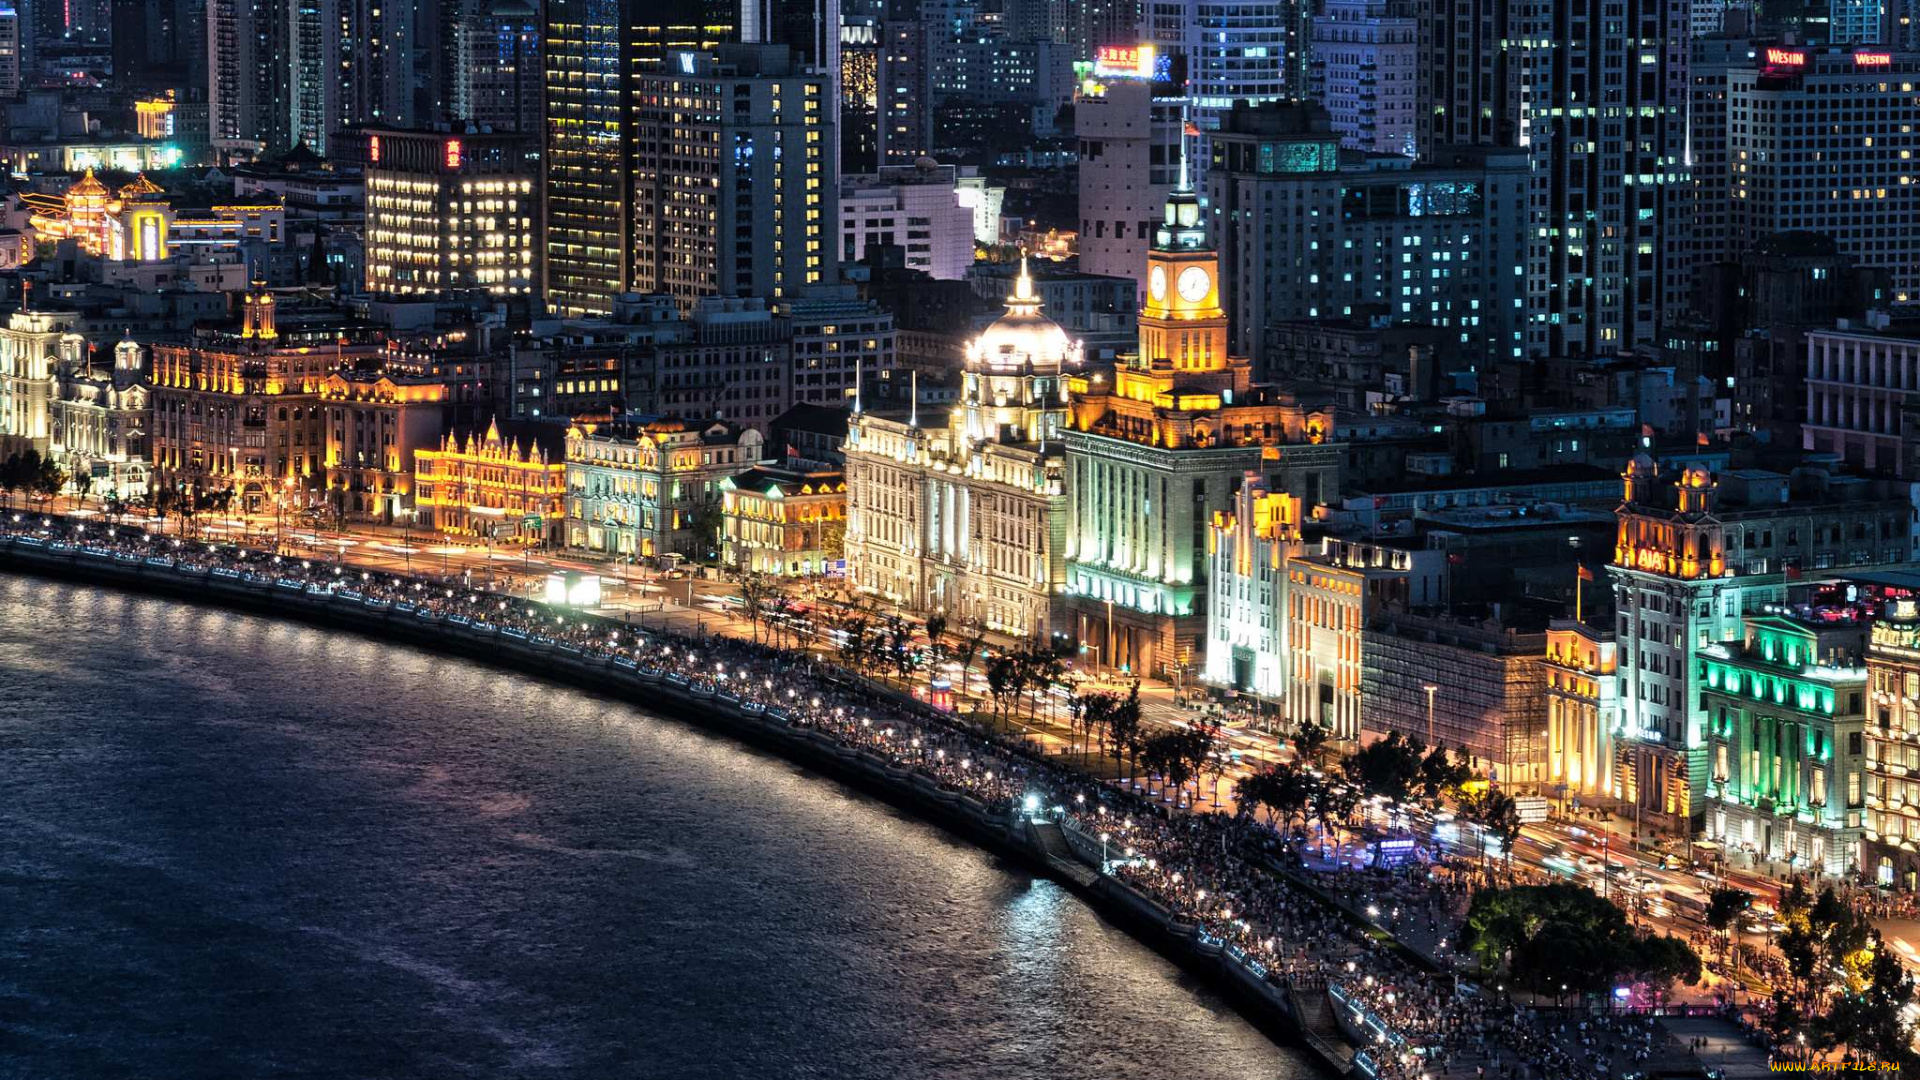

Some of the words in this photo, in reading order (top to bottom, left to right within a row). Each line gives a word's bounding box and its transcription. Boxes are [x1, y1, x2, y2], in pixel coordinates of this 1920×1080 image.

[1768, 49, 1804, 65] WESTIN
[1855, 53, 1890, 65] WESTIN
[1638, 548, 1662, 570] AIA
